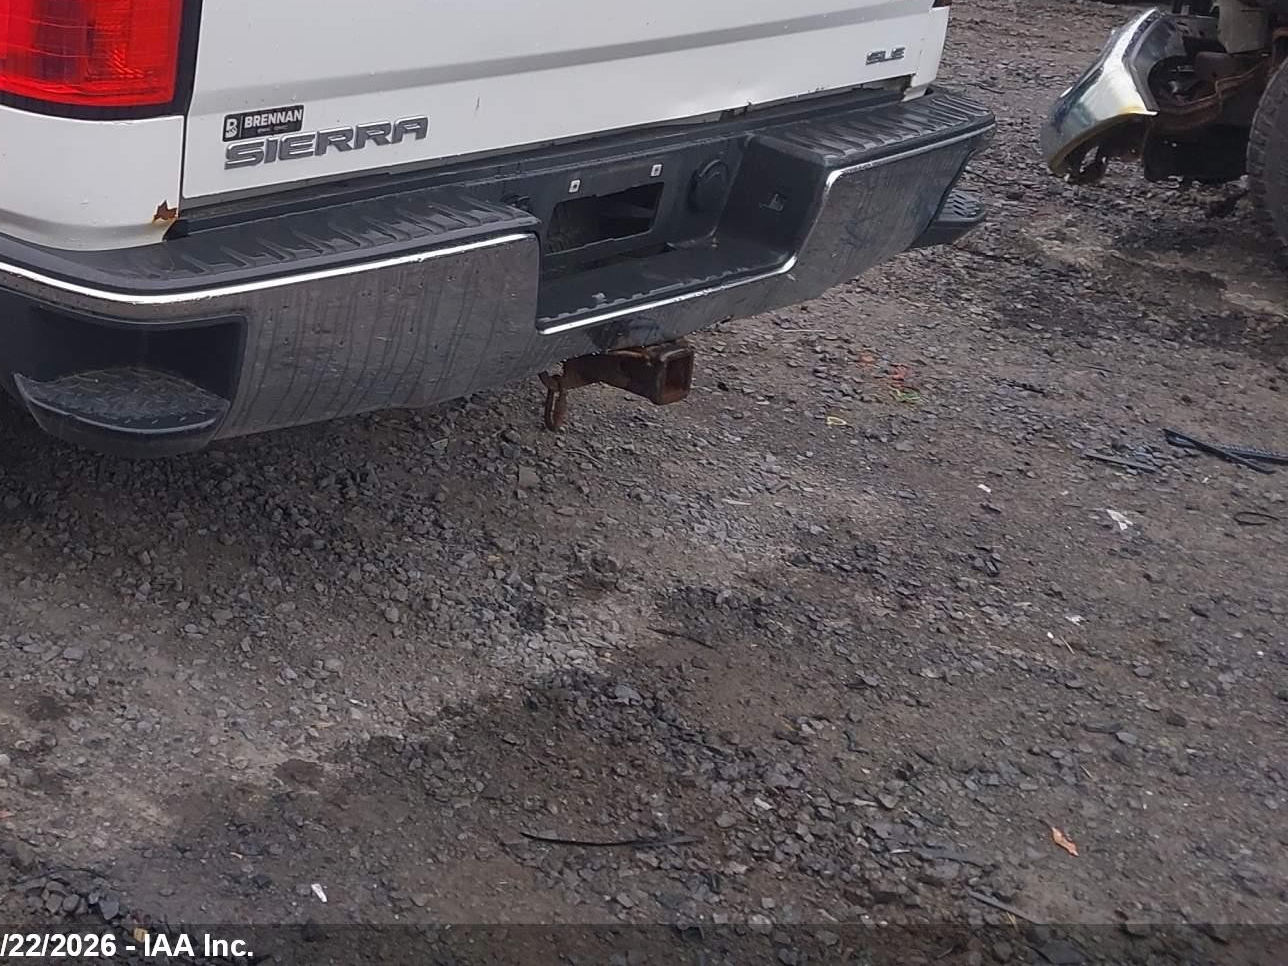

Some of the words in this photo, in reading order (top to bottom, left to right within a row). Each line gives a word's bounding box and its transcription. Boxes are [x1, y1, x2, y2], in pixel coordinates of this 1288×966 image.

[865, 46, 906, 66] SLE
[243, 109, 303, 129] BRENNAN
[224, 115, 430, 170] SIERRA
